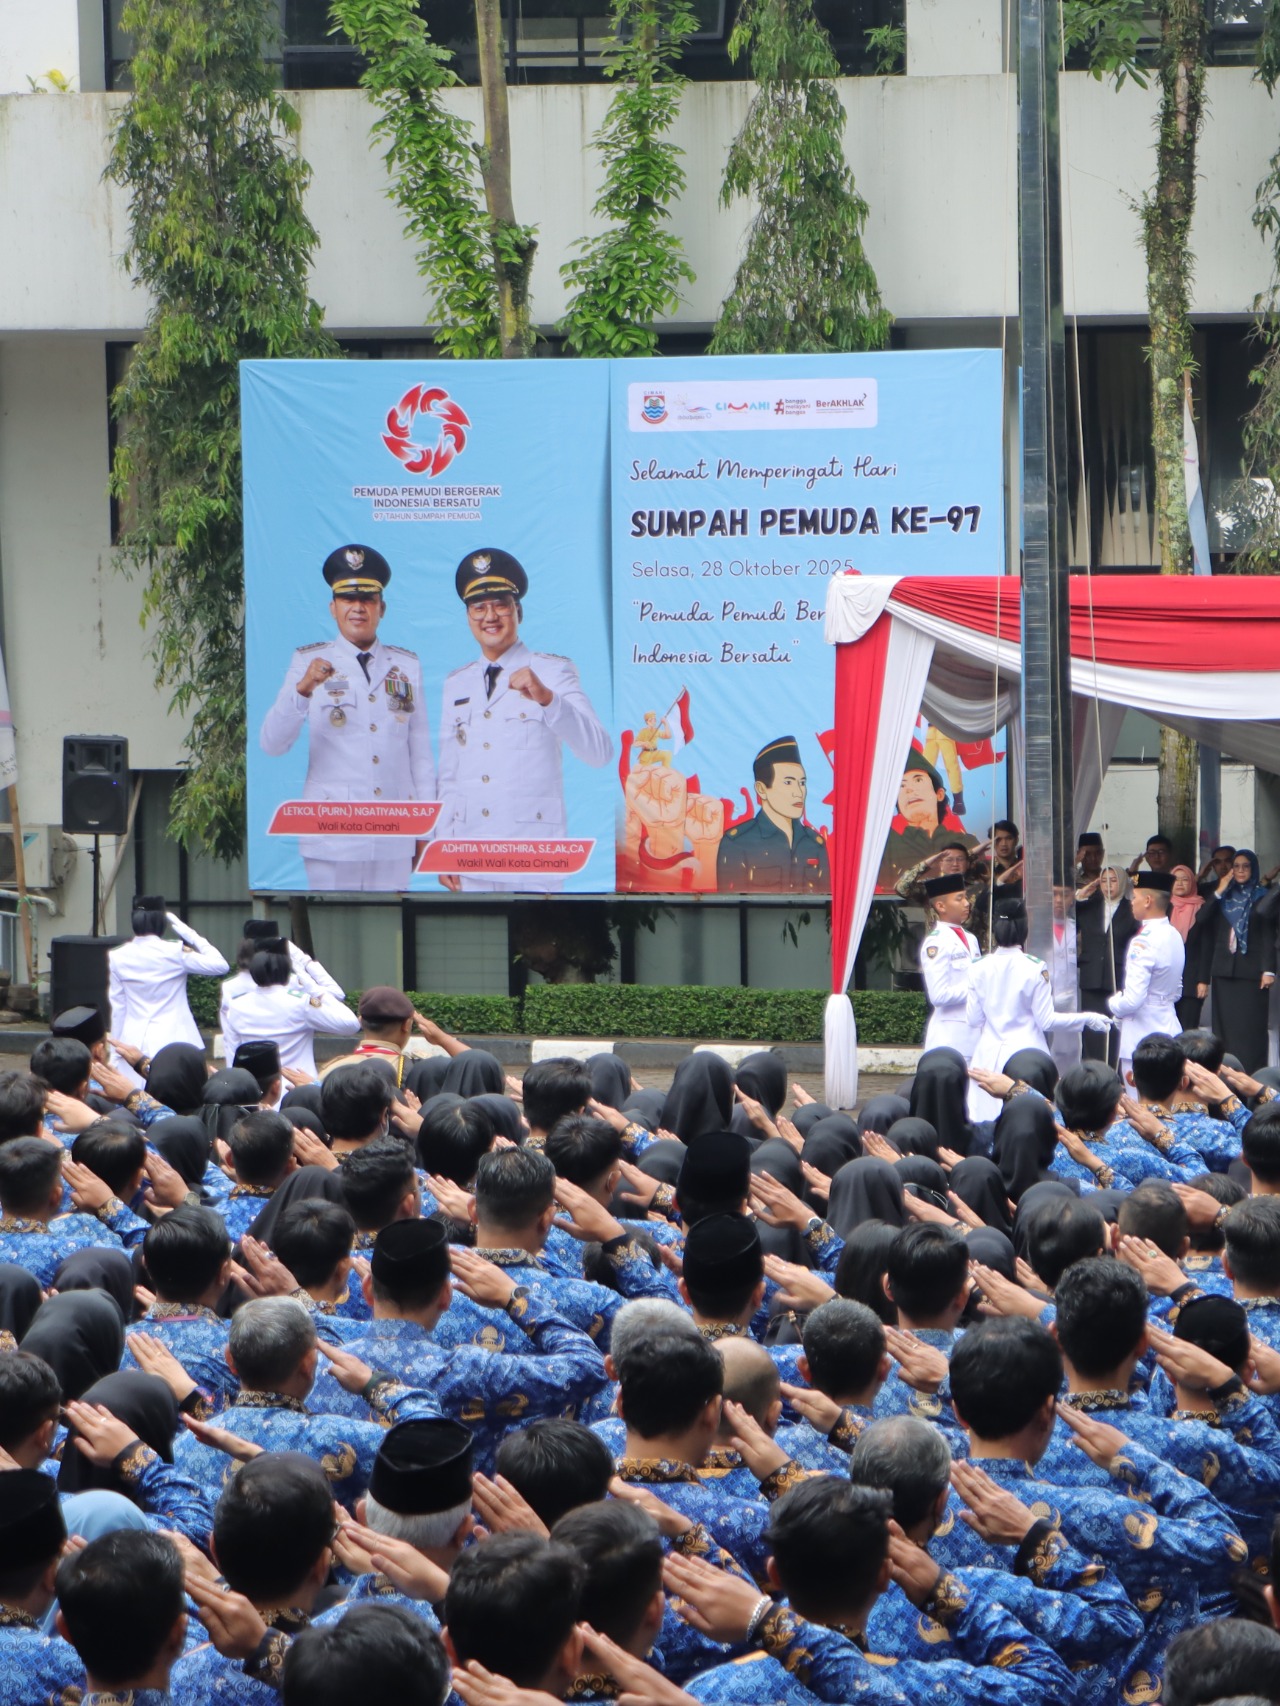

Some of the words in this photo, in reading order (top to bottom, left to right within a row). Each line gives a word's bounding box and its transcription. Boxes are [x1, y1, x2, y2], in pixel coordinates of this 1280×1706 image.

[715, 401, 770, 411] CIMAHI
[816, 398, 865, 408] BerAKHLAK
[630, 458, 709, 482] Selamat
[716, 456, 844, 489] Memperingati
[853, 455, 898, 478] Hari
[354, 487, 399, 497] PEMUDA
[401, 487, 441, 496] PEMUDI
[444, 487, 500, 496] BERGERAK
[374, 498, 430, 508] INDONESIA
[433, 498, 480, 507] BERSATU
[374, 512, 383, 520] 97
[386, 512, 412, 520] TAHUN
[413, 512, 445, 520] SUMPAH
[448, 512, 480, 520] PEMUDA
[630, 508, 749, 538] SUMPAH
[760, 506, 880, 537] PEMUDA
[891, 505, 982, 534] KE-97
[632, 560, 694, 578] Selasa,
[701, 560, 723, 577] 28
[729, 560, 801, 577] Oktober
[721, 600, 786, 622] Pemudi
[796, 599, 826, 621] Ber
[633, 643, 712, 663] Indonesia
[283, 806, 315, 816] LETKOL
[317, 805, 352, 818] (PURN.)
[318, 822, 339, 831] Wali
[340, 822, 362, 831] Kota
[364, 822, 400, 831] Cimahi
[441, 844, 478, 853] ADHITIA
[457, 858, 483, 868] Wakil
[486, 858, 507, 868] Wali
[508, 859, 531, 868] Kota
[533, 858, 569, 868] Cimahi
